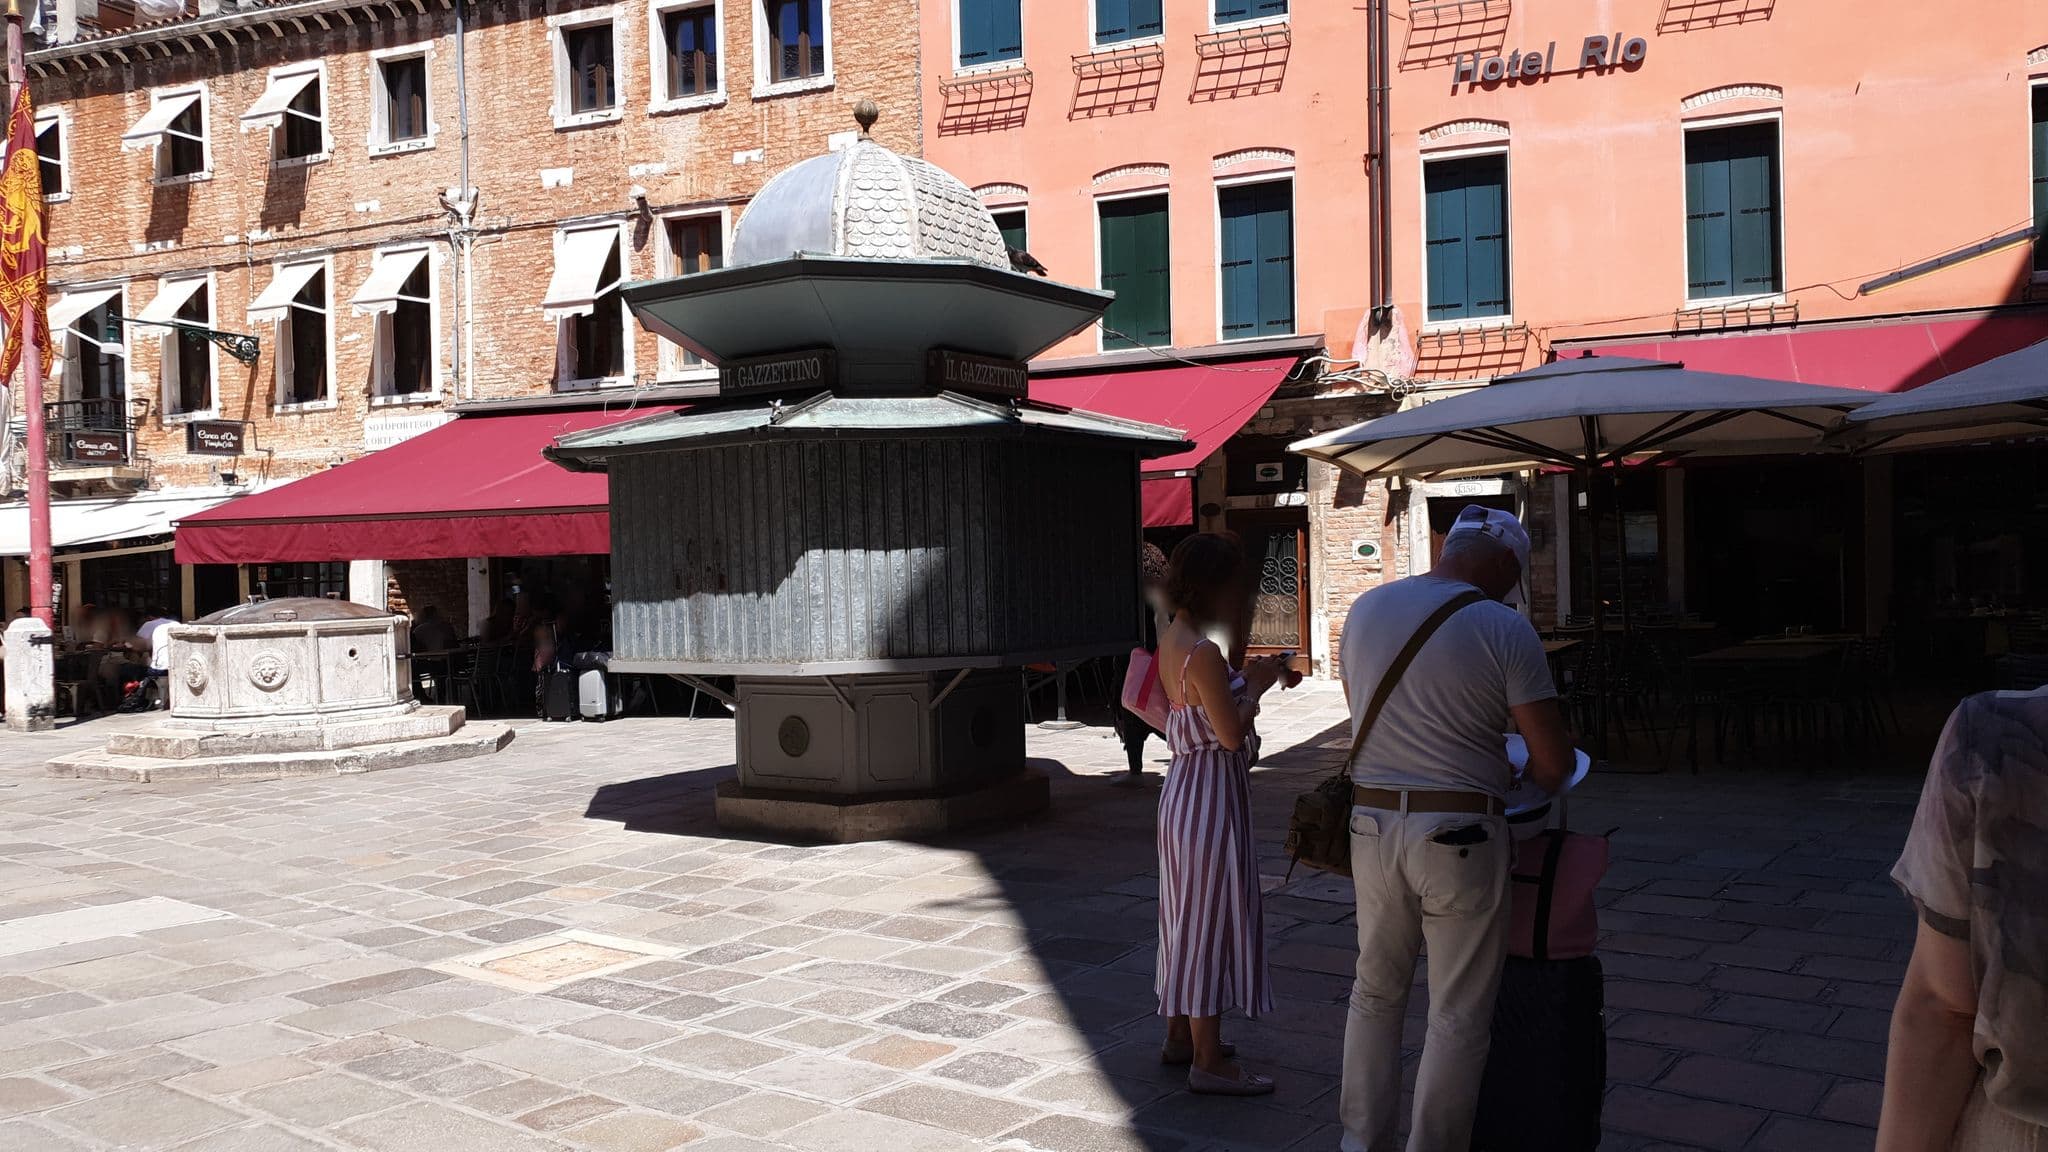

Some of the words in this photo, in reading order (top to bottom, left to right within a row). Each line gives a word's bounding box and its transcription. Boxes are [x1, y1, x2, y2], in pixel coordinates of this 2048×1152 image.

[1453, 41, 1555, 85] Hotel
[722, 368, 735, 390] IL
[738, 357, 822, 387] GAZZETTINO
[945, 358, 959, 381] IL
[960, 360, 1027, 391] GAZZETTINO
[368, 420, 432, 432] SOTOPORTEGO
